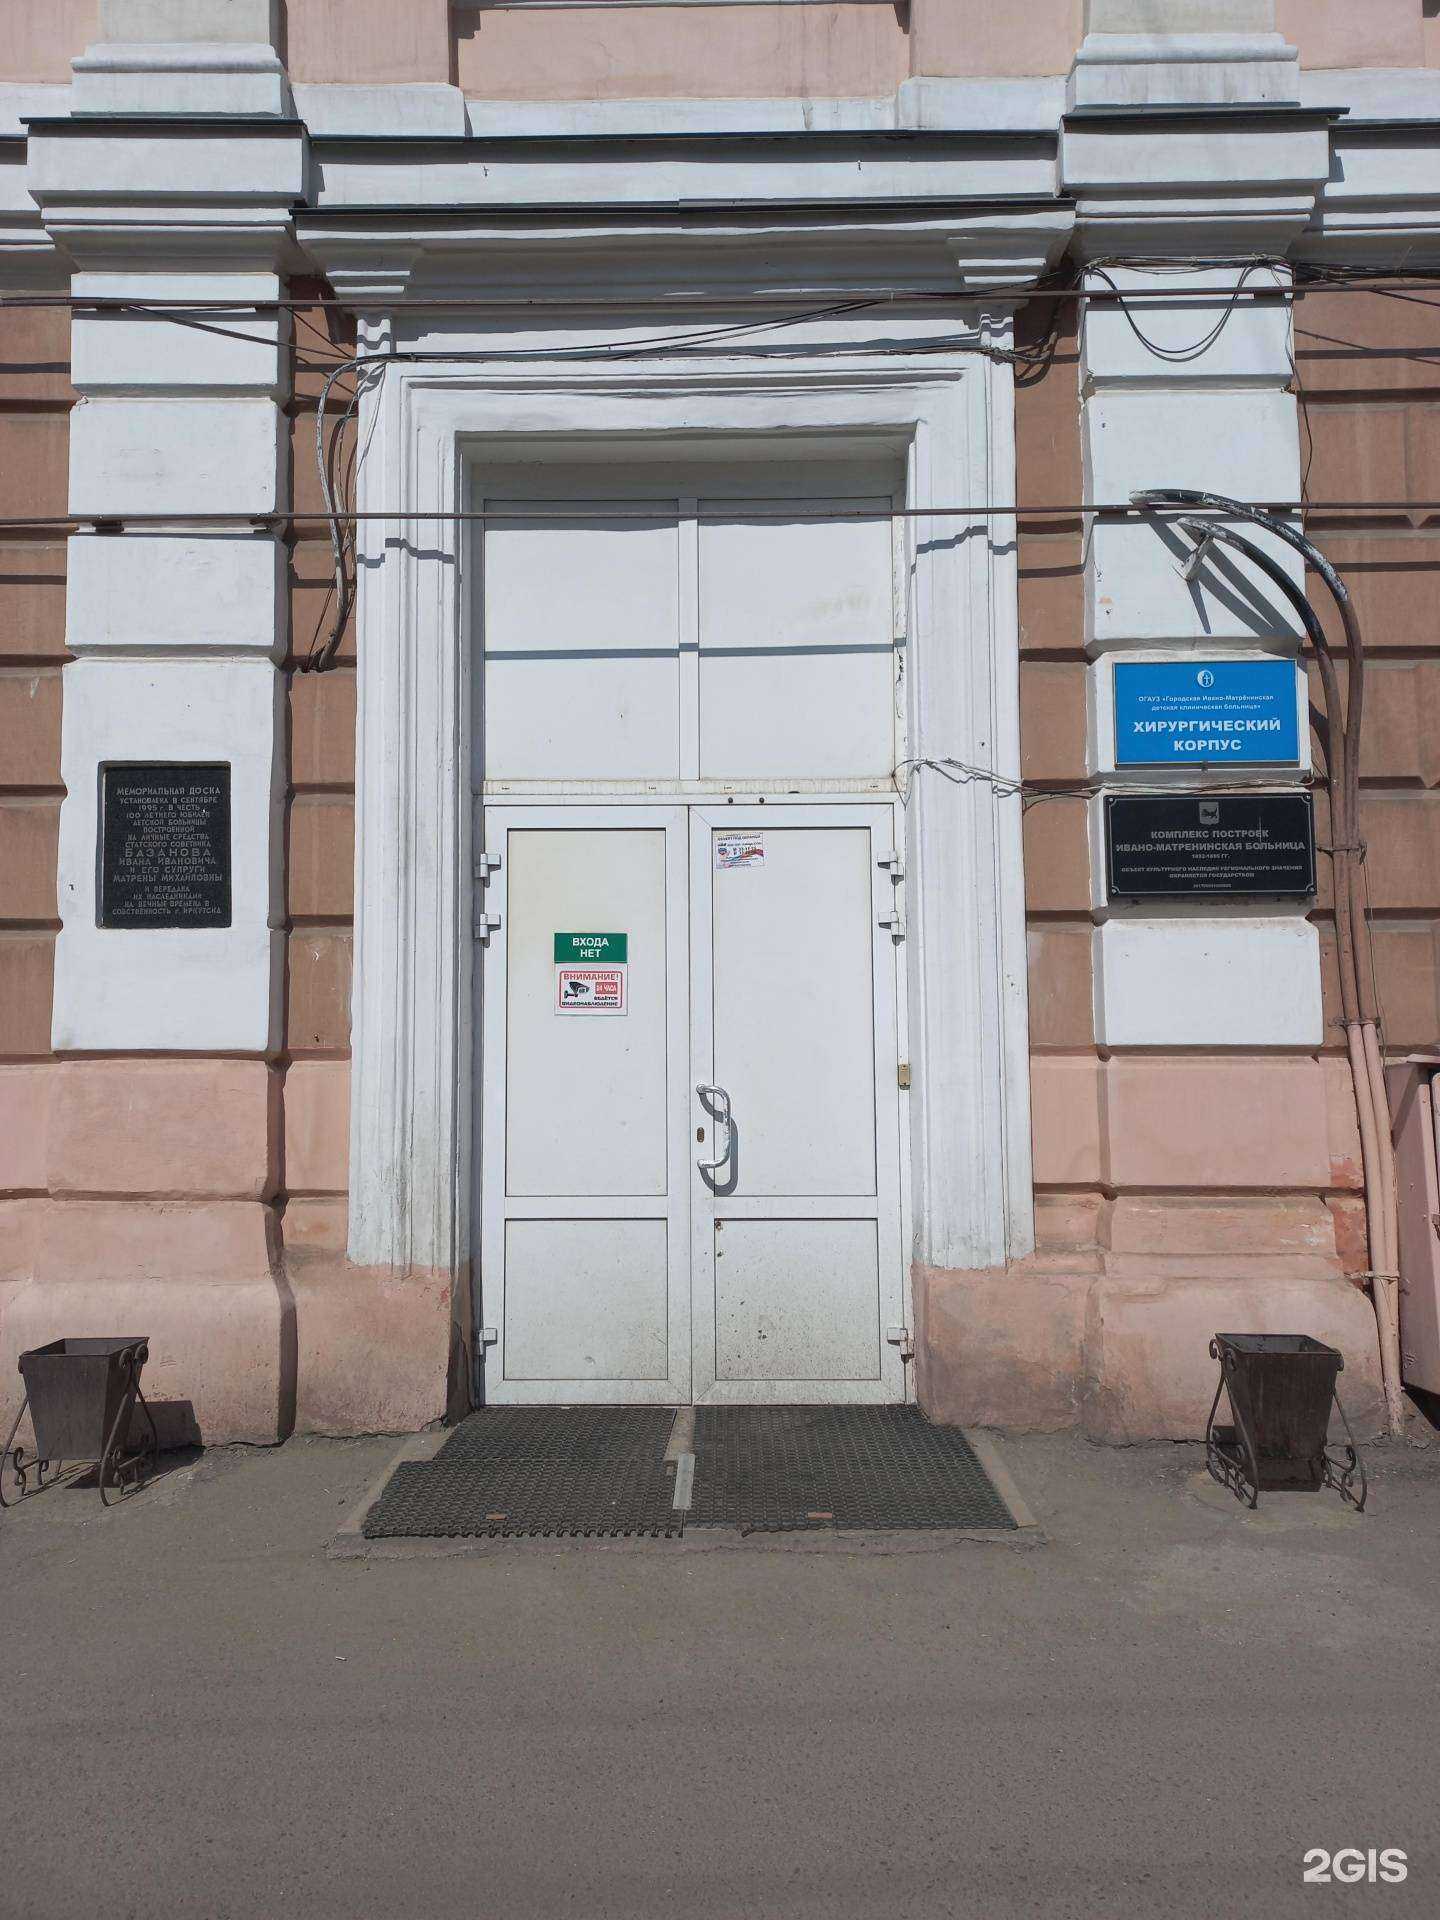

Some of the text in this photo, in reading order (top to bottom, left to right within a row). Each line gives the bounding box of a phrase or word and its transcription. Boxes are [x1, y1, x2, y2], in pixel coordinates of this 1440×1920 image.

[1151, 704, 1178, 712] детская
[1133, 717, 1281, 733] ХИРУРГИЧЕСКИЙ
[1173, 739, 1243, 751] КОРПУС
[116, 786, 221, 796] МЕМОРИАЛЬНАЯ ДОСКА
[120, 795, 218, 804] УСТАНОВЛЕНА В СЕНТЯБРЕ
[138, 804, 158, 812] 1995
[177, 803, 200, 811] ЧЕСТЬ
[125, 811, 210, 819] 100 ЛЕТНЕГО ЮБИЛЕЯ
[168, 818, 208, 826] БОЛЬНИЦЫ
[128, 833, 209, 841] НА ЛИЧНЫЕ СРЕДСТВА
[1150, 829, 1270, 839] КОМПЛЕКС ПОСТРОЕК
[124, 840, 212, 849] СТАТСКОГО СОВЕТНИКА
[1115, 841, 1306, 852] ИВАНО-МАТРЕНИНСКАЯ БОЛЬНИЦА
[124, 848, 211, 857] БАЗАНОВА
[119, 856, 217, 866] ИВАНА ИВАНОВИЧА
[164, 865, 206, 873] СУПРУГИ
[112, 873, 157, 883] МАТРЕНЫ
[112, 907, 171, 915] СОБСТВЕННОСТЬ
[182, 907, 222, 915] ИРКУТСКА
[572, 937, 609, 947] ВХОДА
[580, 949, 602, 958] НЕТ
[563, 973, 619, 981] ВНИМАНИЕ!
